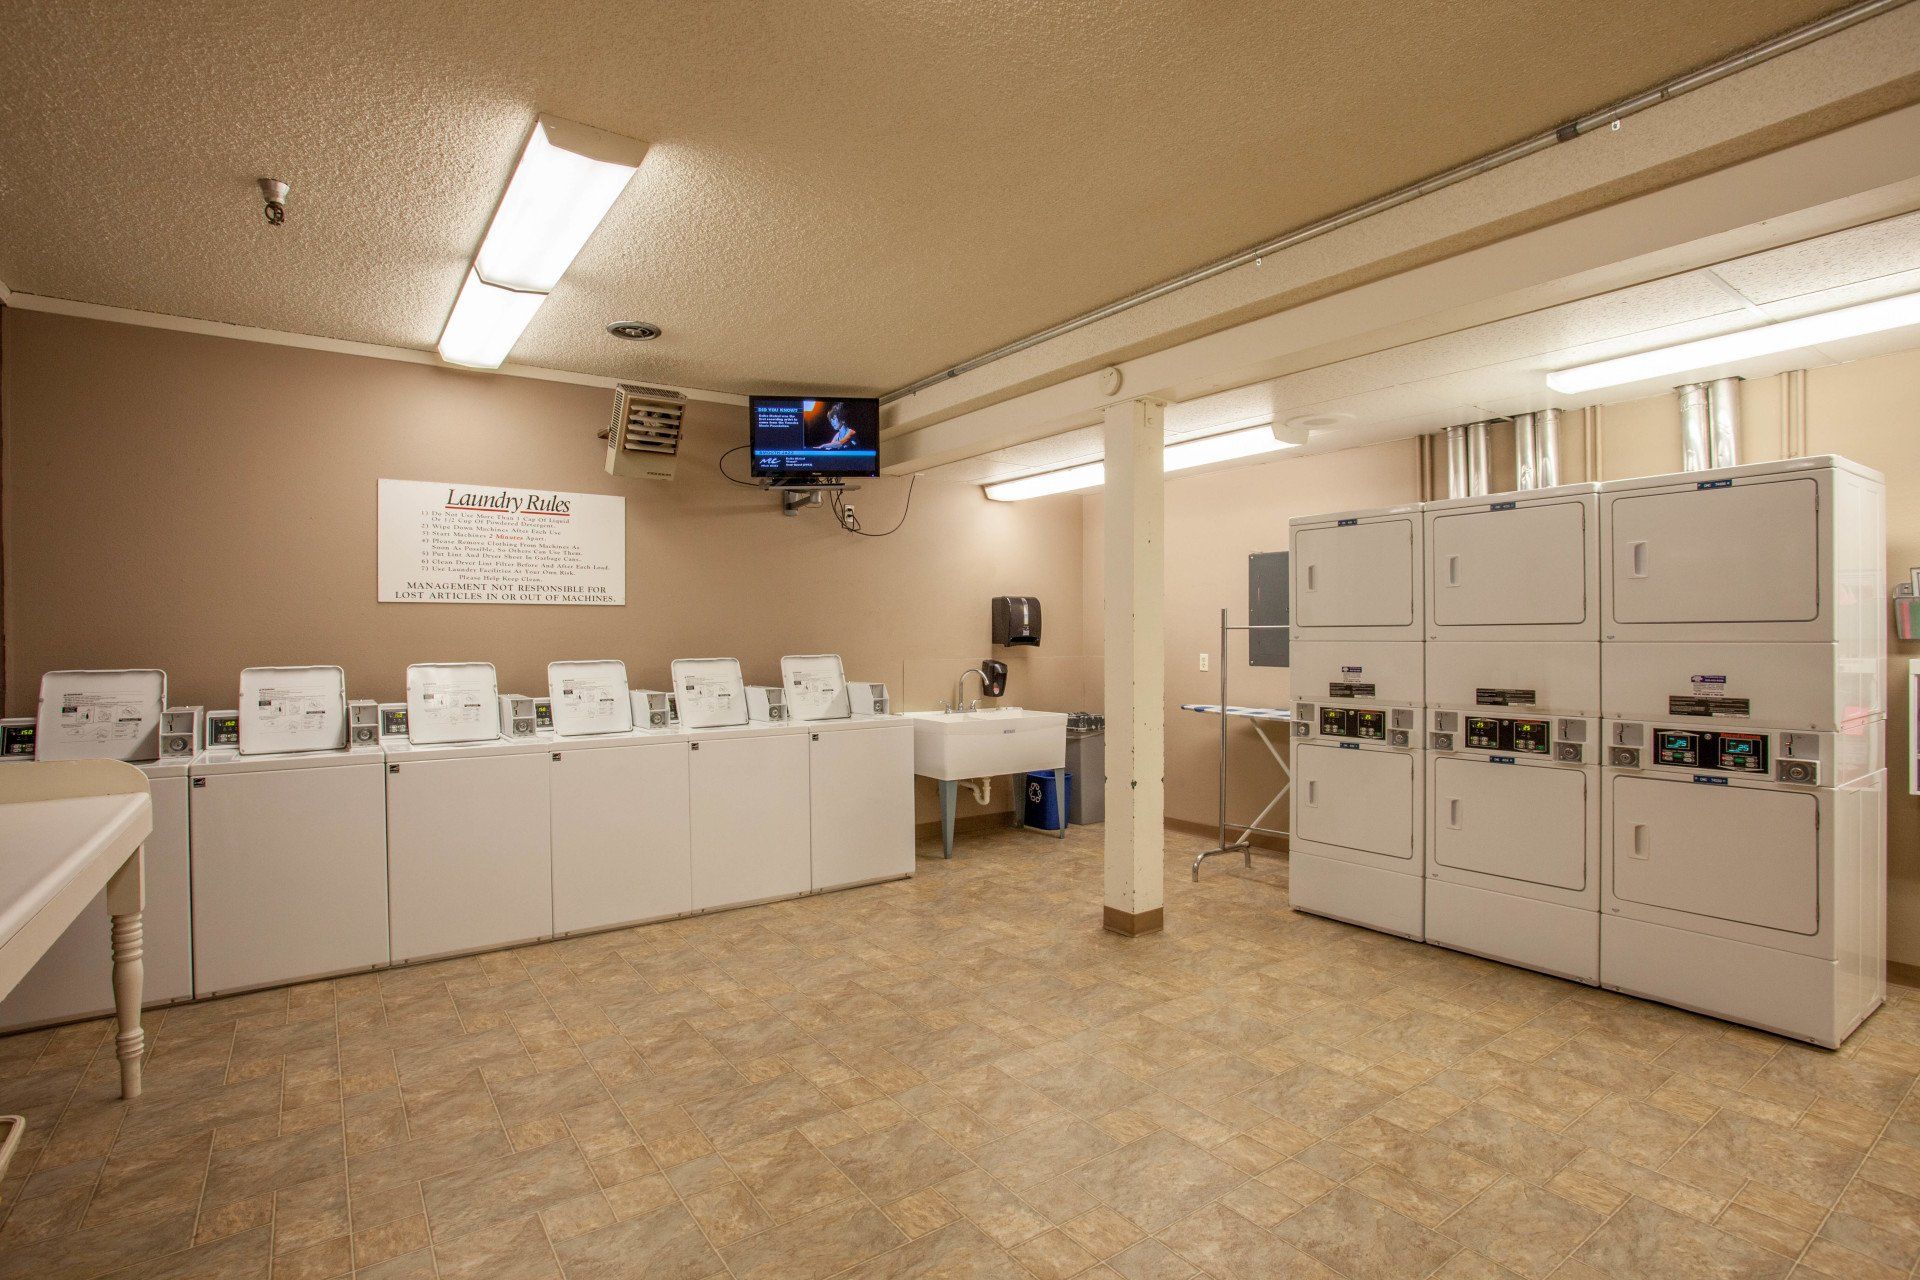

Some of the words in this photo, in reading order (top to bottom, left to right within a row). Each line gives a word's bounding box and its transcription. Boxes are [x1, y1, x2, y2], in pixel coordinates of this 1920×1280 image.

[446, 488, 523, 514] Laundry
[526, 494, 571, 513] Rules
[486, 519, 518, 527] Powdered
[487, 540, 518, 548] Clothing
[406, 581, 487, 591] MANAGEMENT
[491, 583, 514, 591] NOT
[518, 584, 585, 593] RESPONSIBLE
[587, 586, 607, 594] FOR
[395, 591, 424, 599] LOST
[429, 592, 483, 600] ARTICLES
[486, 592, 498, 600] IN
[501, 593, 517, 601] OR
[545, 594, 560, 602] OF
[1737, 744, 1749, 752] 25
